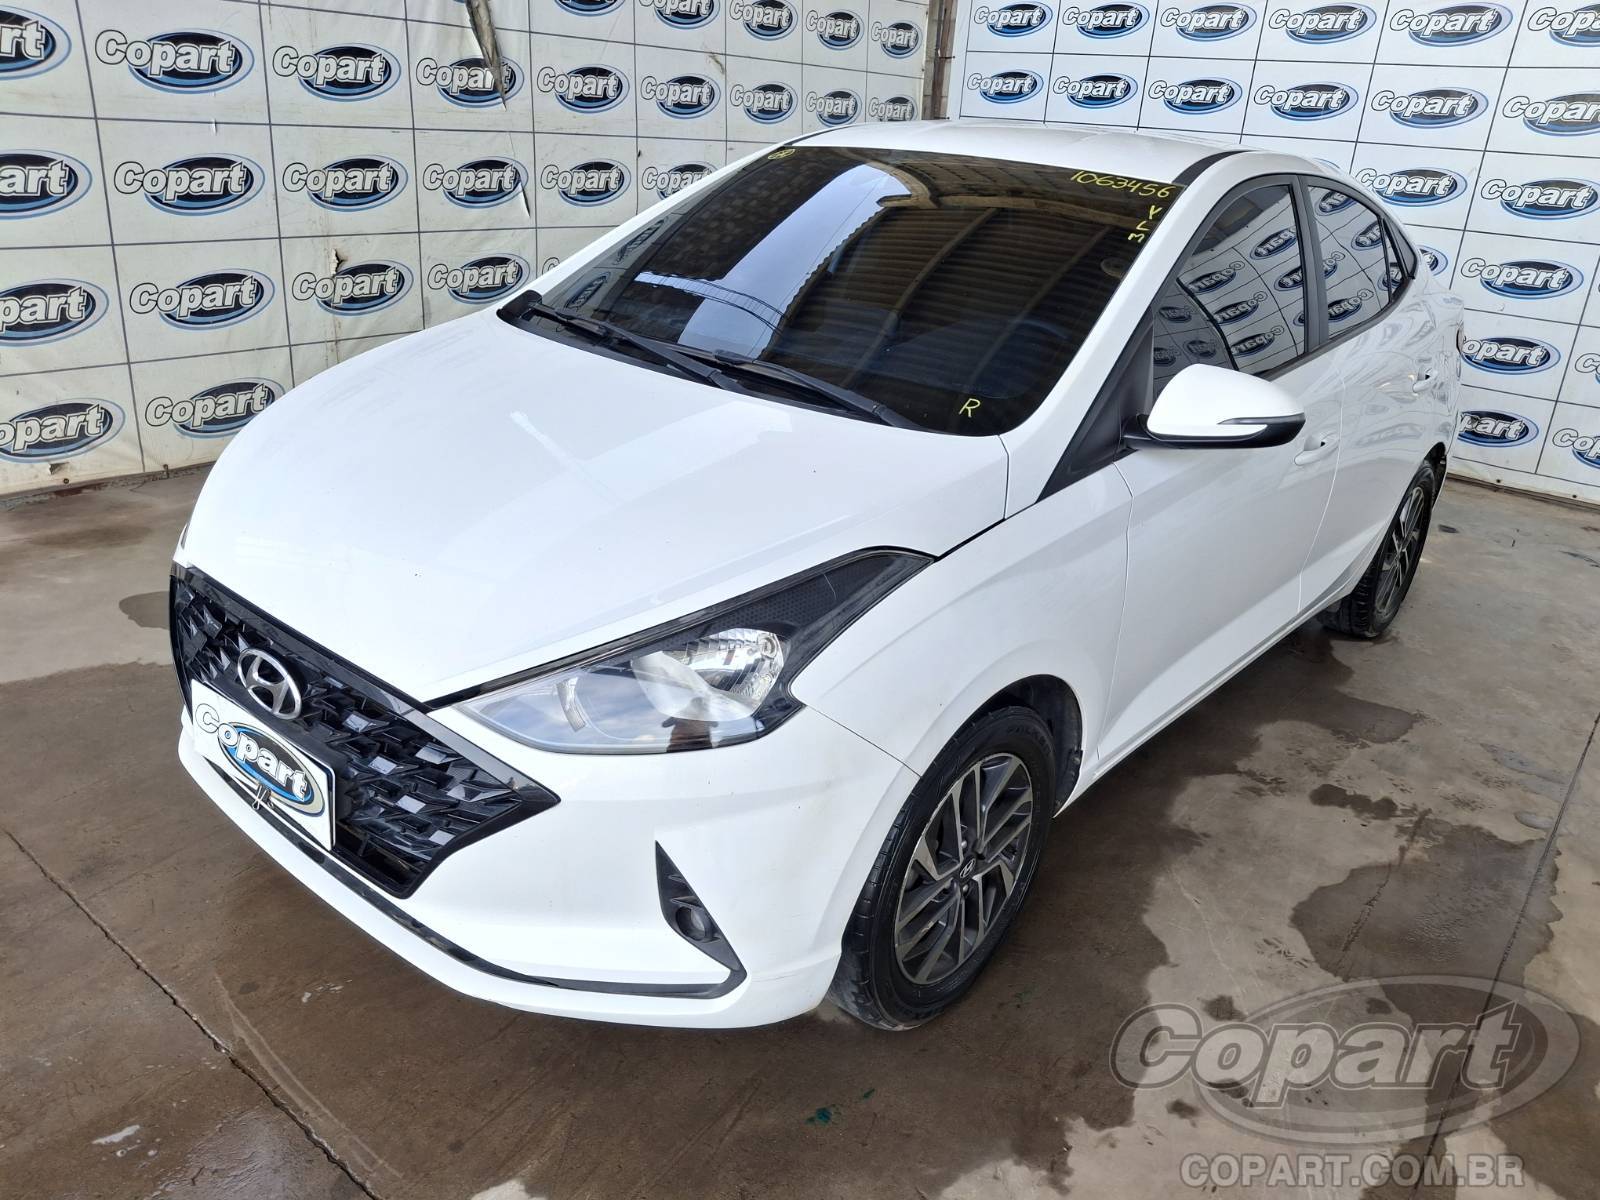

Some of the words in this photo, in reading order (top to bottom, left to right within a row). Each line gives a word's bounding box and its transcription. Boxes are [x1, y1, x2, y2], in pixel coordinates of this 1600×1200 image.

[729, 0, 790, 28] Copart
[805, 10, 857, 40] Copart
[974, 6, 1043, 28] Copart
[1062, 6, 1137, 29] Copart
[1160, 8, 1245, 33] Copart
[1269, 9, 1364, 35] Copart
[1390, 8, 1499, 37] Copart
[871, 21, 917, 48] Copart
[95, 29, 236, 76] Copart
[272, 45, 387, 86] Copart
[537, 66, 620, 100] Copart
[640, 76, 711, 107] Copart
[730, 84, 790, 111] Copart
[967, 73, 1036, 95] Copart
[1053, 76, 1127, 100] Copart
[1148, 80, 1232, 105] Copart
[1253, 85, 1345, 109] Copart
[805, 91, 857, 117] Copart
[868, 97, 913, 121] Copart
[1371, 90, 1474, 118] Copart
[1502, 95, 1600, 125] Copar
[114, 161, 246, 201] Copart
[283, 162, 394, 199] Copart
[423, 163, 515, 196] Copart
[540, 164, 621, 196] Copart
[1071, 170, 1176, 198] 1063456
[1356, 168, 1453, 197] Copart
[1481, 179, 1593, 209] Copart
[292, 266, 401, 304] Copart
[427, 260, 518, 295] Copart
[1460, 257, 1570, 290] Copart
[0, 286, 87, 332] part
[130, 276, 258, 318] Copart
[1463, 335, 1546, 367] opart
[145, 383, 270, 429] Copart
[959, 398, 981, 418] R
[0, 405, 104, 452] opart
[1459, 412, 1527, 440] part
[195, 703, 308, 801] Copart
